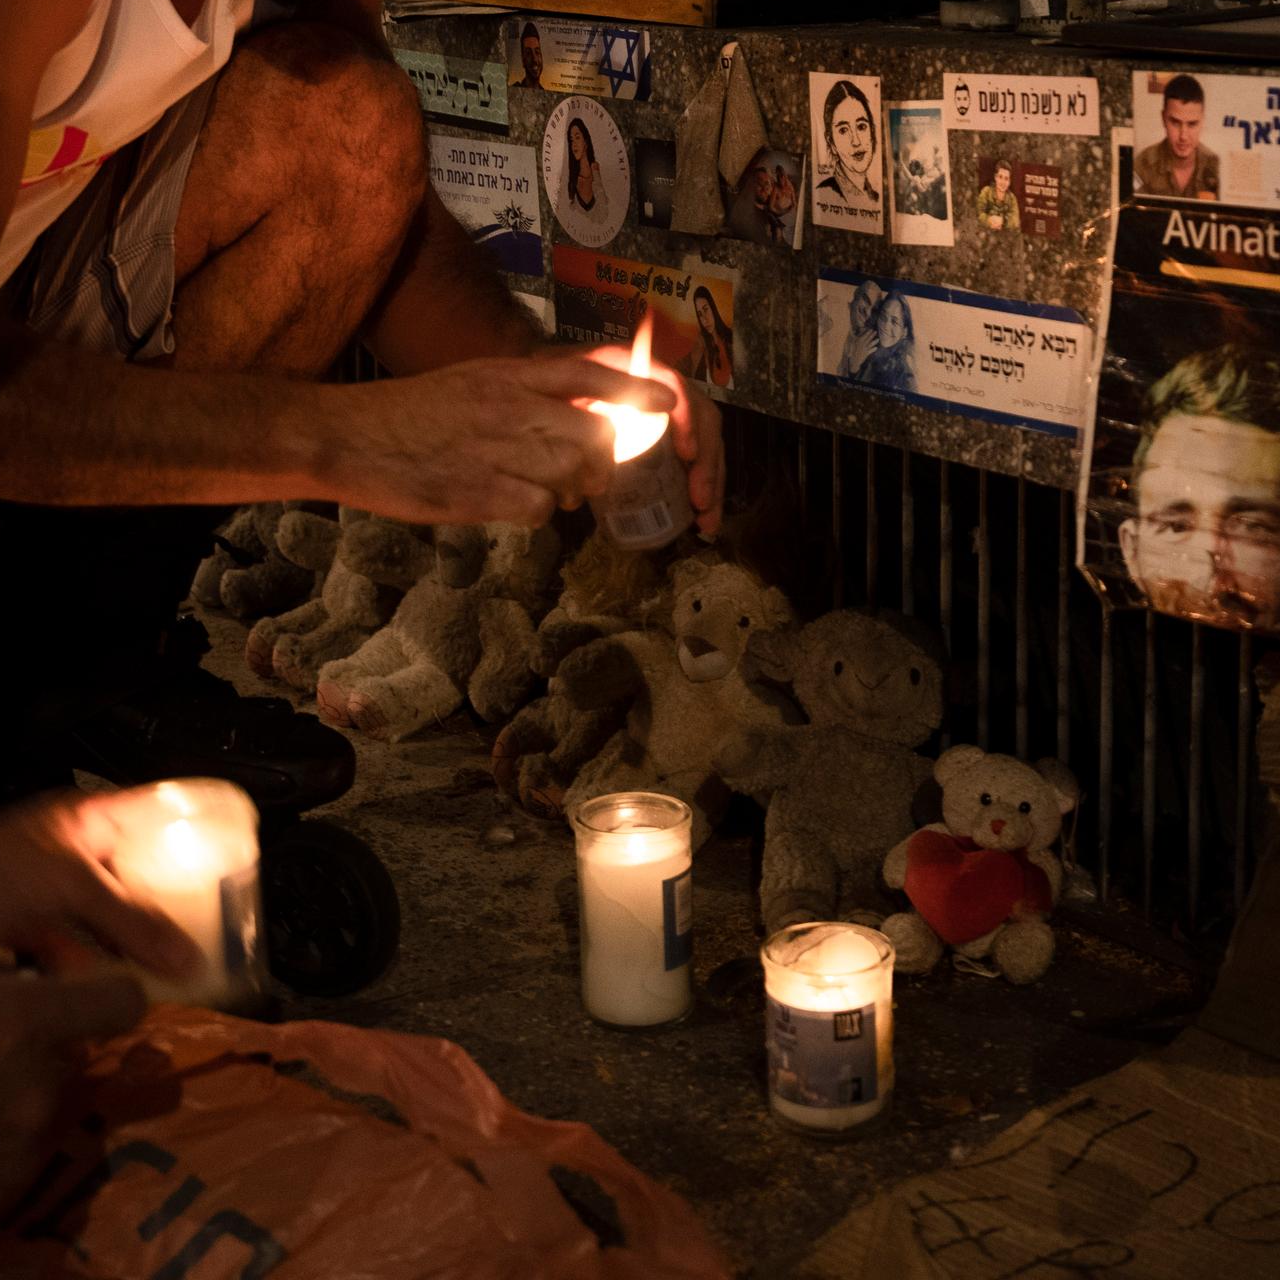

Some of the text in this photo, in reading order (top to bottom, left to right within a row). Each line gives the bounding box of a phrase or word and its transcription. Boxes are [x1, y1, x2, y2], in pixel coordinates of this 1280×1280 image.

[470, 149, 491, 168] אדם
[447, 169, 475, 186] באמת
[478, 172, 498, 189] אדם
[500, 173, 513, 191] כל
[515, 178, 529, 194] לא
